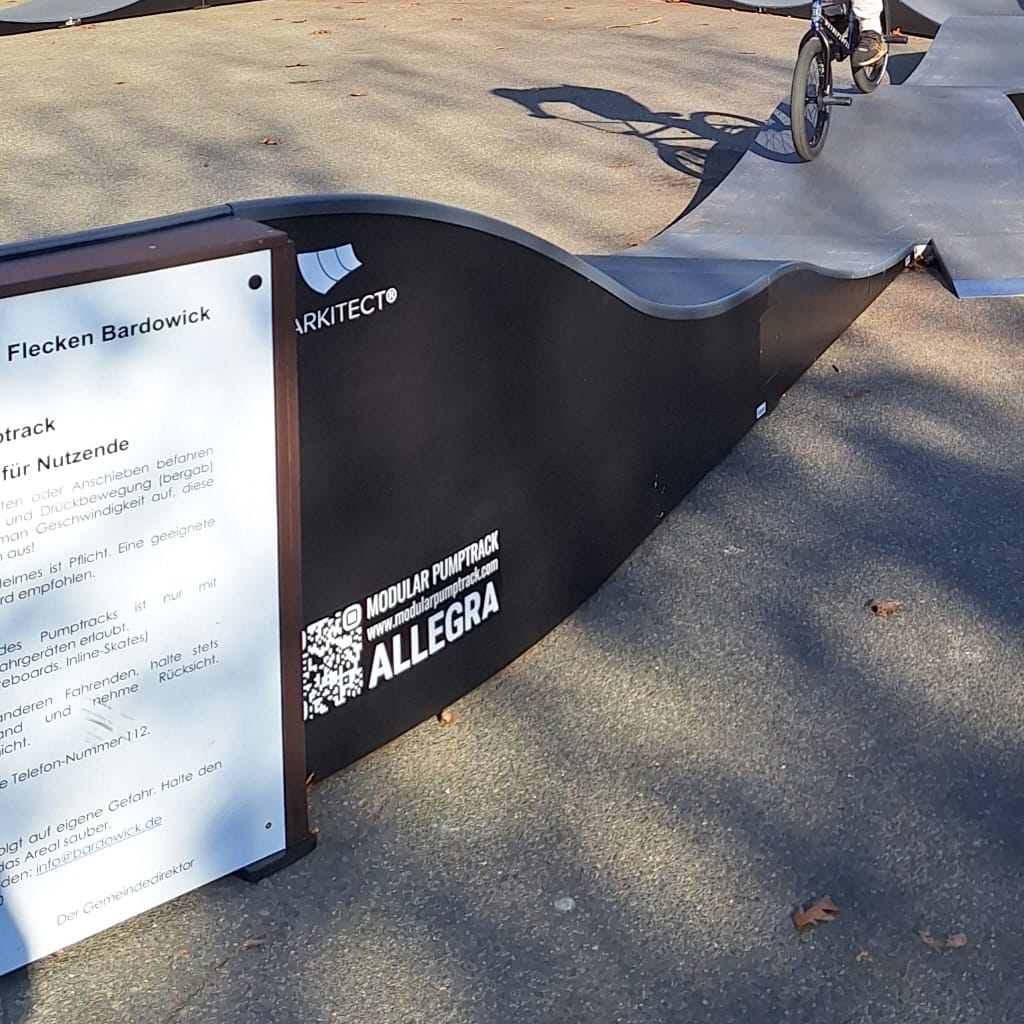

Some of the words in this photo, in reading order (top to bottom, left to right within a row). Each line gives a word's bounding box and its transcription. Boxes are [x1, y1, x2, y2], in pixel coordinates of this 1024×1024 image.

[7, 332, 94, 362] Flecken
[102, 306, 211, 342] Bardowick
[2, 462, 30, 481] für
[37, 438, 130, 472] Nutzende
[32, 486, 64, 503] oder
[72, 463, 150, 492] Anschieben
[156, 447, 214, 470] befahren
[6, 511, 33, 526] und
[41, 479, 152, 517] Drückbewegung
[159, 461, 214, 487] (bergab)
[35, 496, 145, 534] Geschwindigkeit
[182, 477, 214, 494] diese
[7, 541, 35, 560] aus!
[50, 561, 62, 575] ist
[69, 547, 111, 568] Pflicht.
[118, 538, 145, 554] Eine
[150, 517, 216, 546] geeignete
[18, 569, 96, 600] empfohlen.
[366, 569, 430, 620] MODULAR
[432, 529, 499, 585] PUMPTRACK
[366, 558, 499, 642] www.modularpumptrack.com
[41, 610, 118, 642] Pumptracks
[134, 600, 146, 613] ist
[163, 589, 183, 604] nur
[199, 577, 217, 592] mit
[80, 622, 129, 646] erlaubt.
[368, 581, 500, 689] ALLEGRA
[66, 630, 149, 667] Inline-Skates)
[150, 652, 183, 671] halte
[192, 638, 219, 656] stets
[45, 705, 72, 724] und
[92, 683, 139, 707] nehme
[159, 654, 219, 683] Rücksicht.
[0, 736, 31, 757] icht.
[11, 737, 123, 785] Telefon-Nummer
[28, 825, 52, 845] auf
[56, 808, 103, 834] eigene
[108, 786, 156, 813] Gefahr.
[160, 771, 193, 792] Halte
[197, 760, 223, 777] den
[24, 840, 60, 863] Areal
[63, 821, 112, 847] sauber.
[36, 815, 163, 876] info@bardowick.de
[57, 909, 80, 927] Der
[83, 858, 196, 914] Gemeindedirektor
